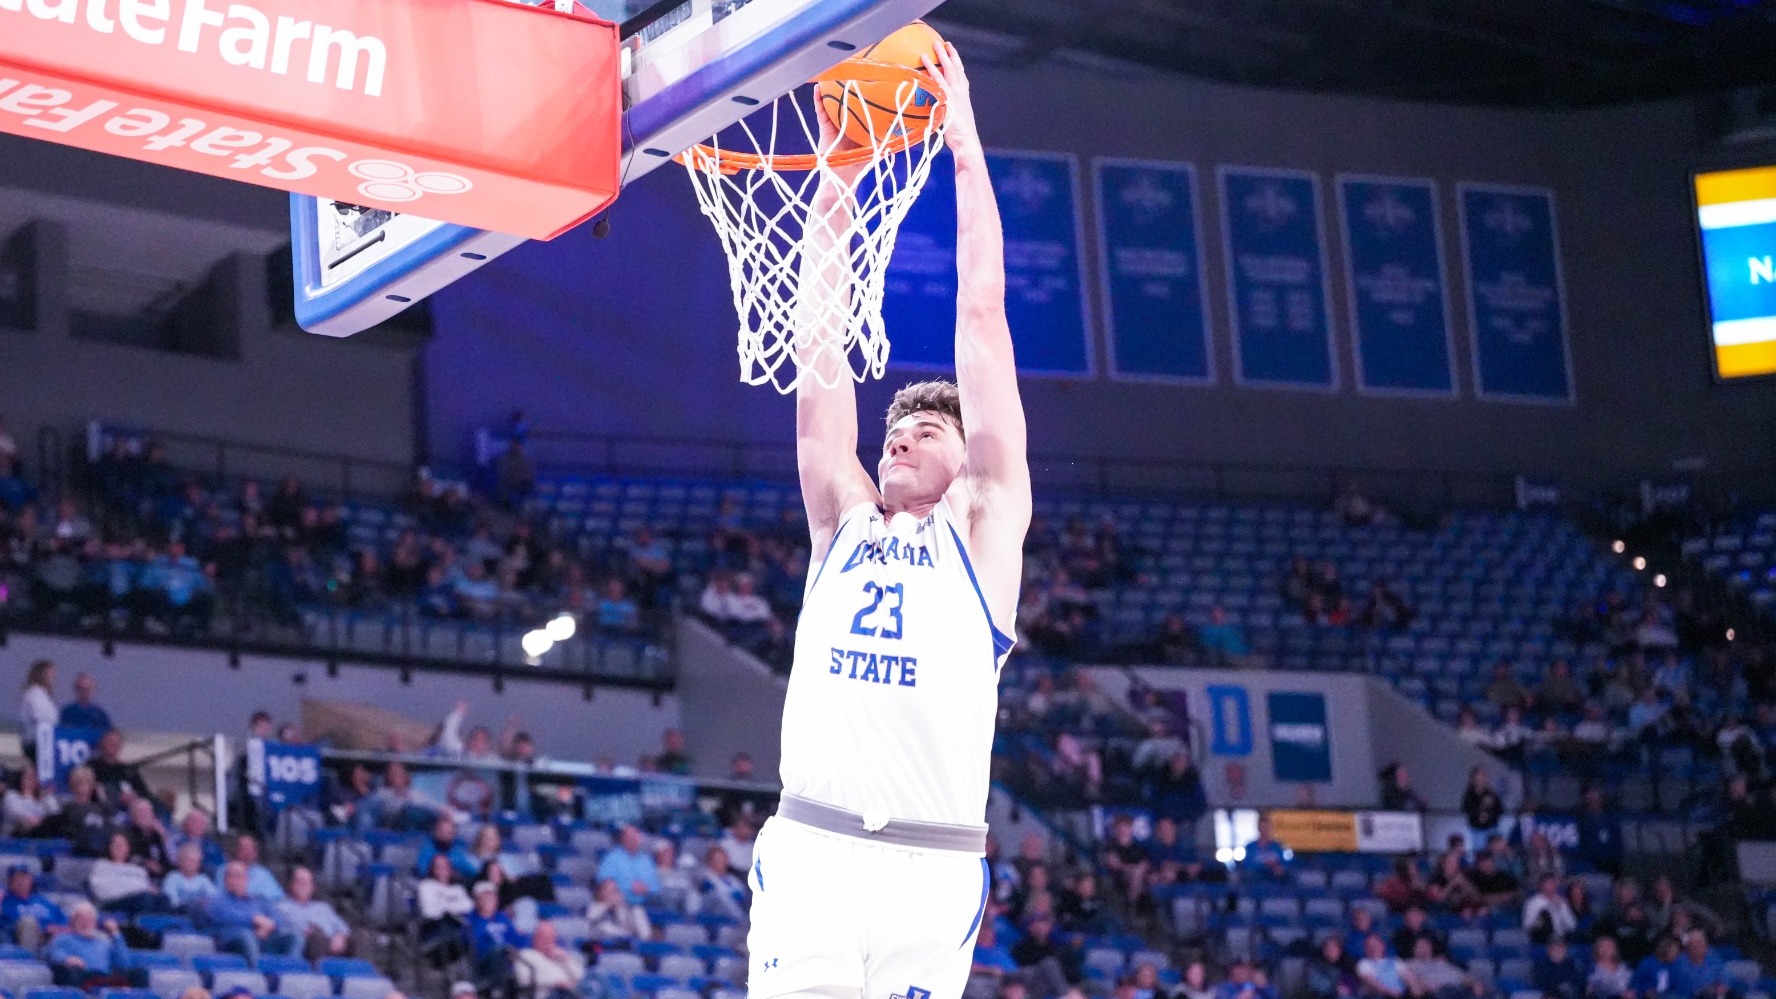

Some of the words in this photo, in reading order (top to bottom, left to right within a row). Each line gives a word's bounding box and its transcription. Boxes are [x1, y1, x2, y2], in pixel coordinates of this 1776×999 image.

[104, 108, 348, 180] State
[1748, 255, 1776, 285] N
[850, 580, 904, 640] 23
[829, 647, 917, 688] STATE
[269, 755, 318, 785] 105
